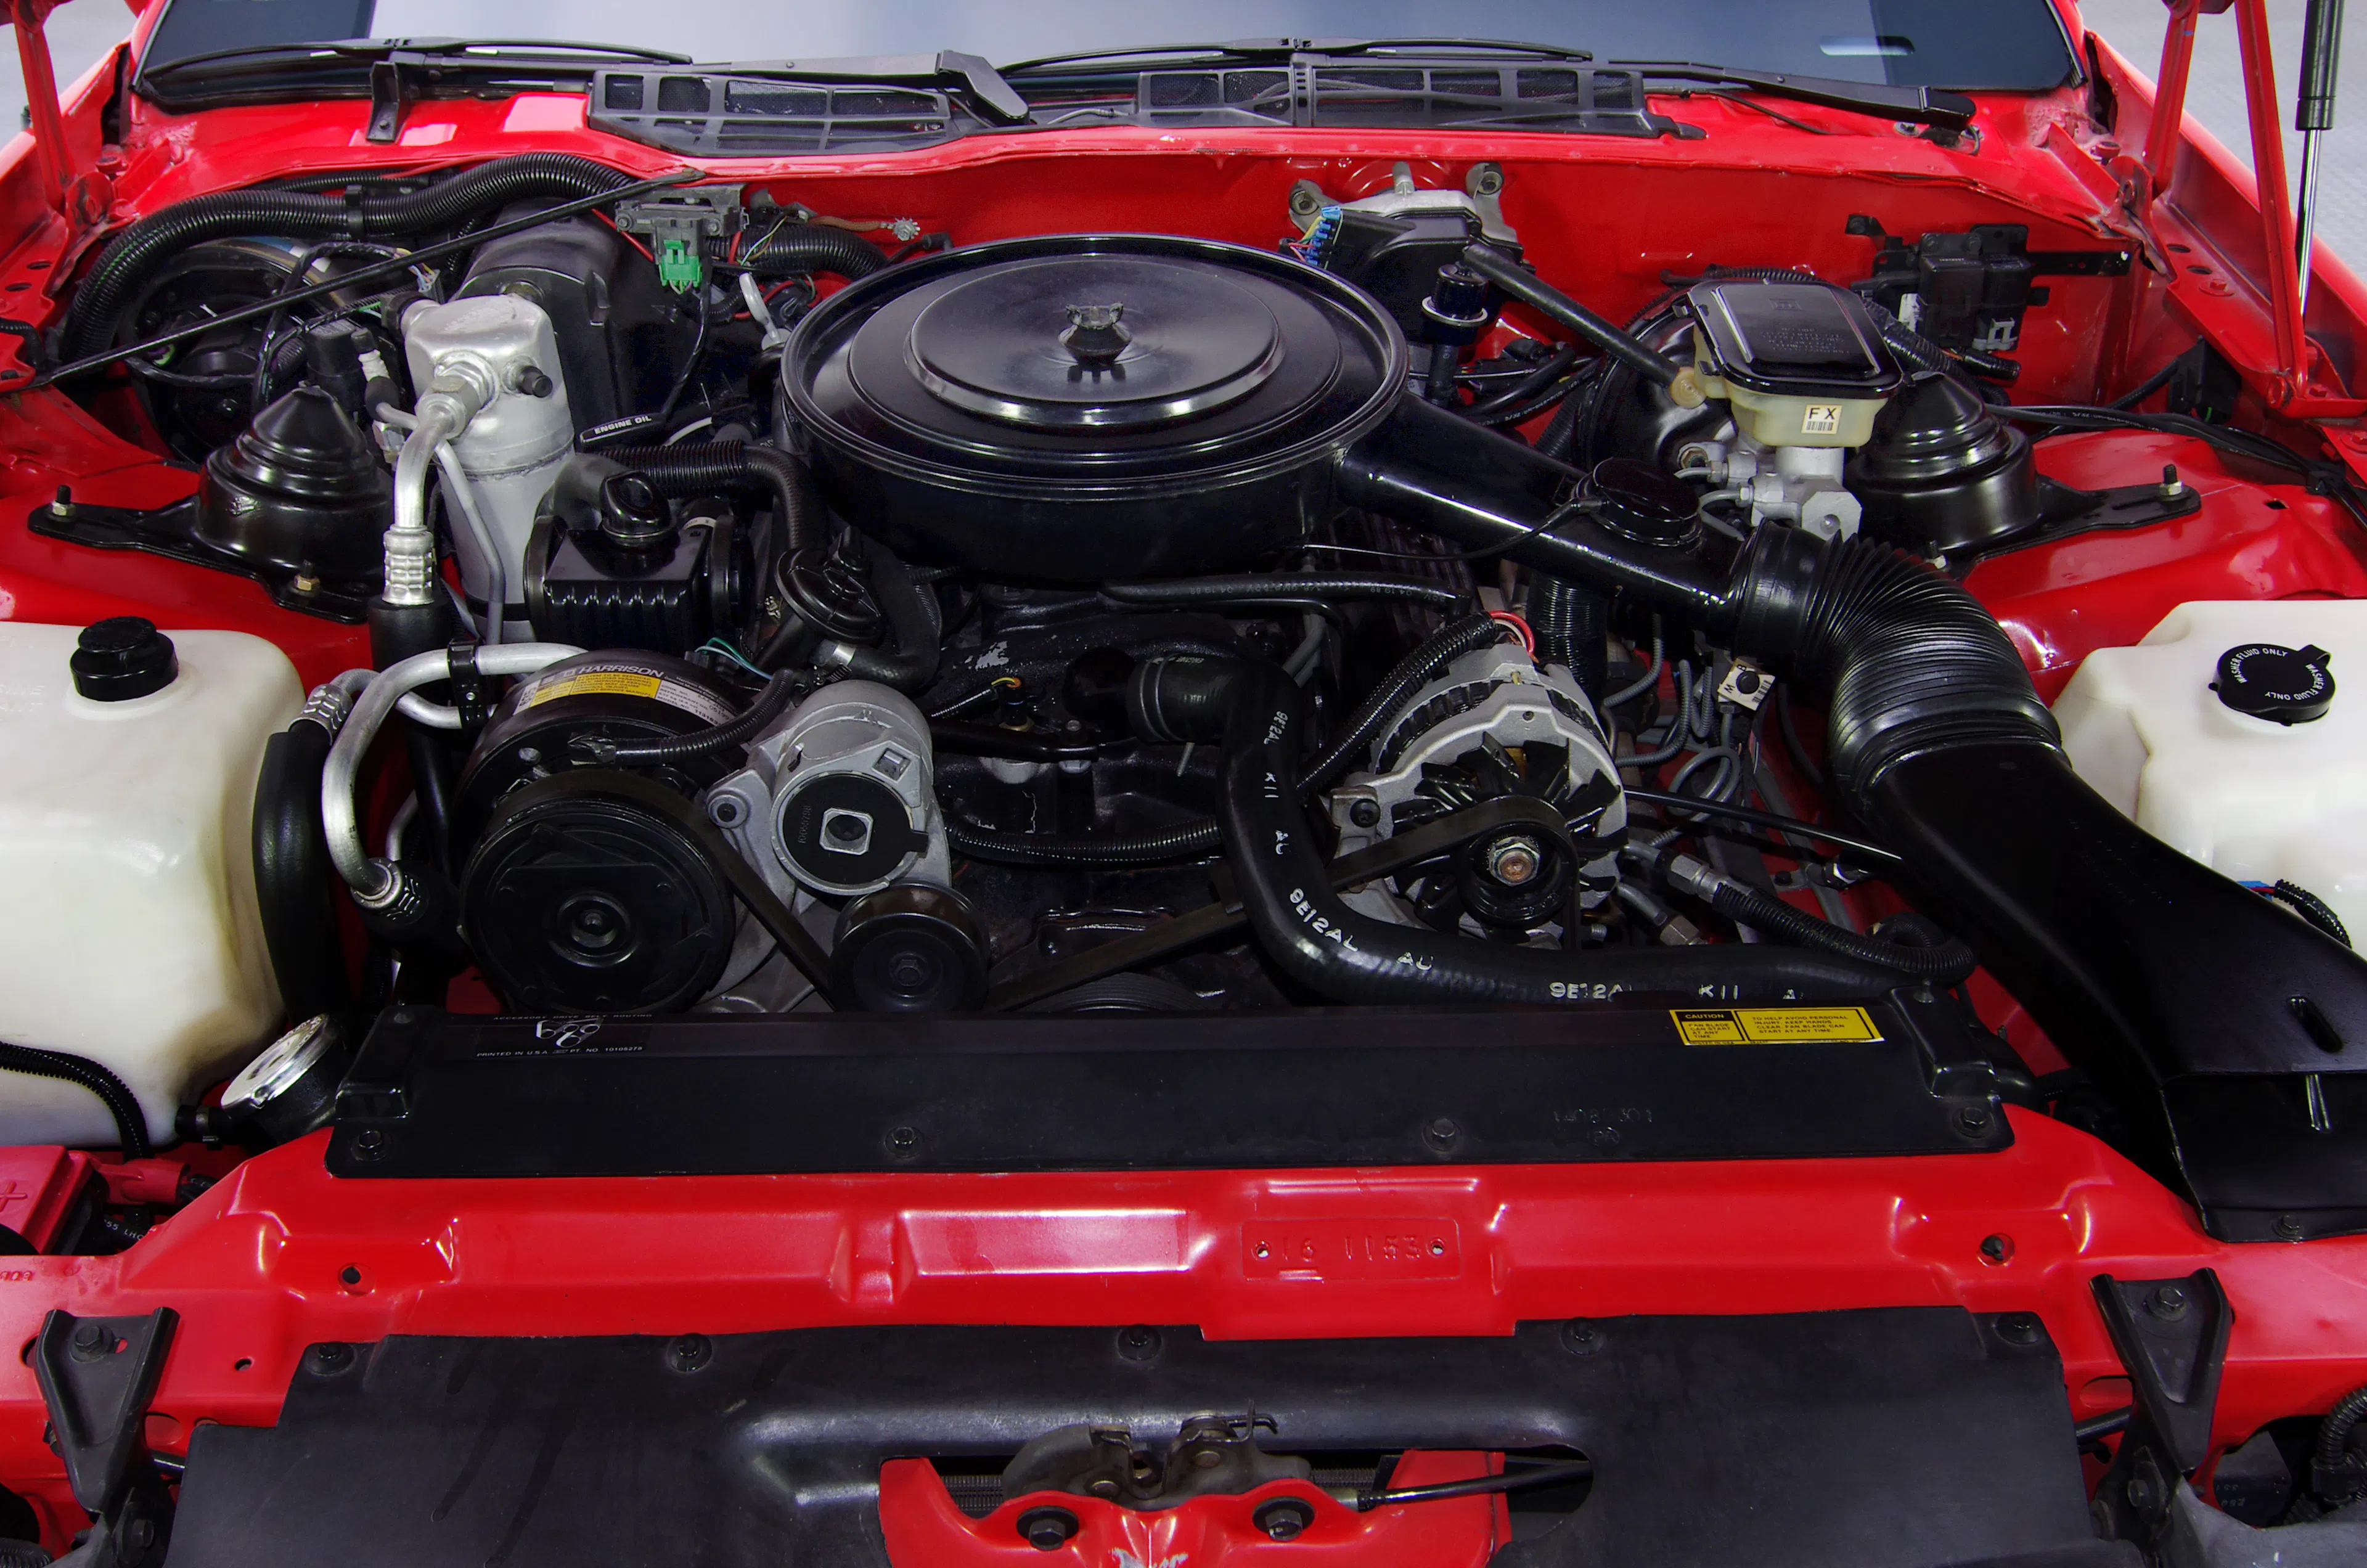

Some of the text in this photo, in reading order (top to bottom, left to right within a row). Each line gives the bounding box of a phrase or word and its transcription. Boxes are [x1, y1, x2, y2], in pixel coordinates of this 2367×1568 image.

[594, 415, 652, 435] ENGINE OIL
[579, 664, 664, 677] HARRISON
[2230, 648, 2288, 684] WASHER FLUID ONLY
[2265, 663, 2324, 701] WASHER FLUID ONLY
